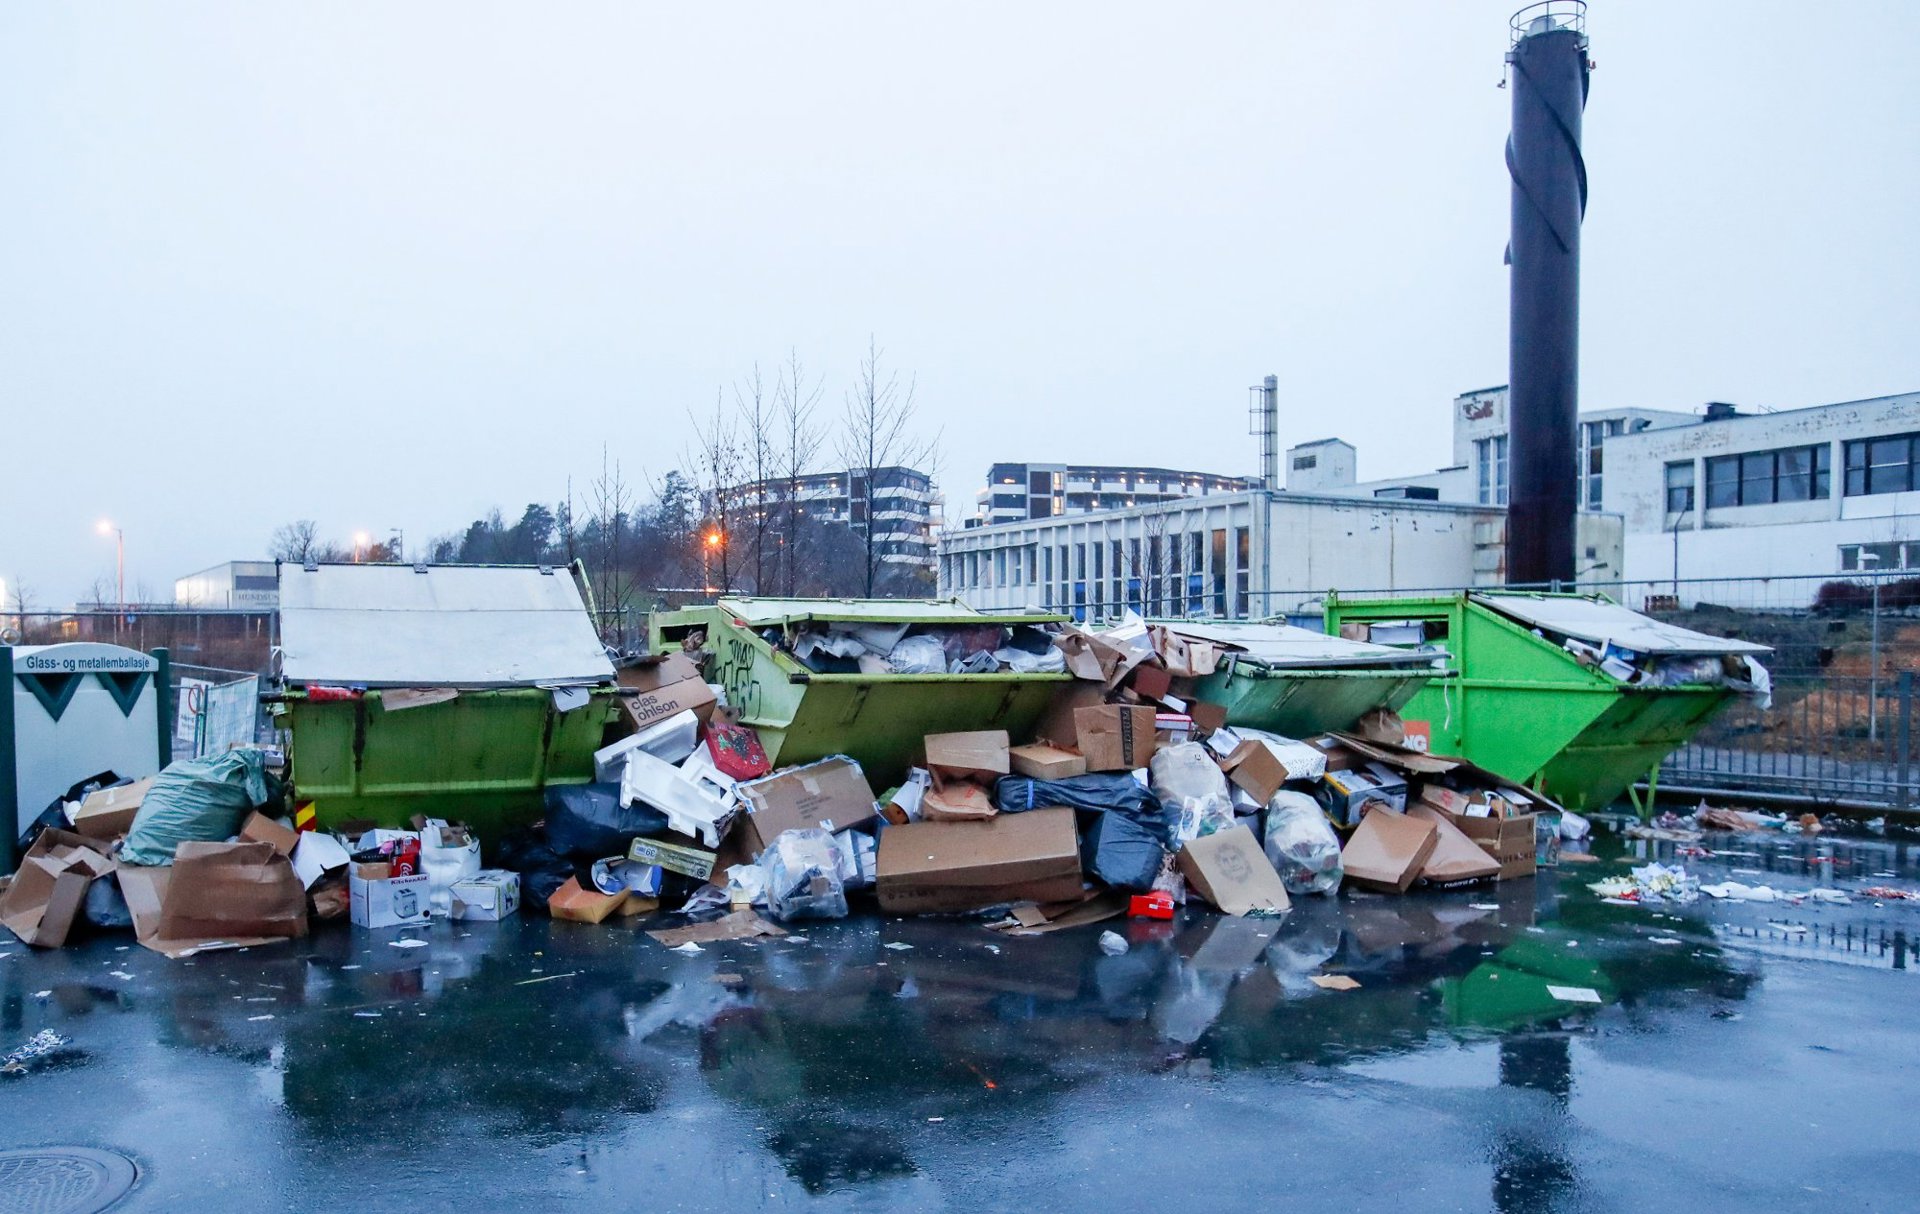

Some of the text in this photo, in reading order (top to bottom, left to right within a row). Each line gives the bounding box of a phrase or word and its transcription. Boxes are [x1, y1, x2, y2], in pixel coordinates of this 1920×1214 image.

[26, 656, 150, 671] Glass- og metallemballasje
[631, 695, 658, 710] clas
[637, 699, 680, 721] ohlson
[390, 876, 428, 886] KitchenAid
